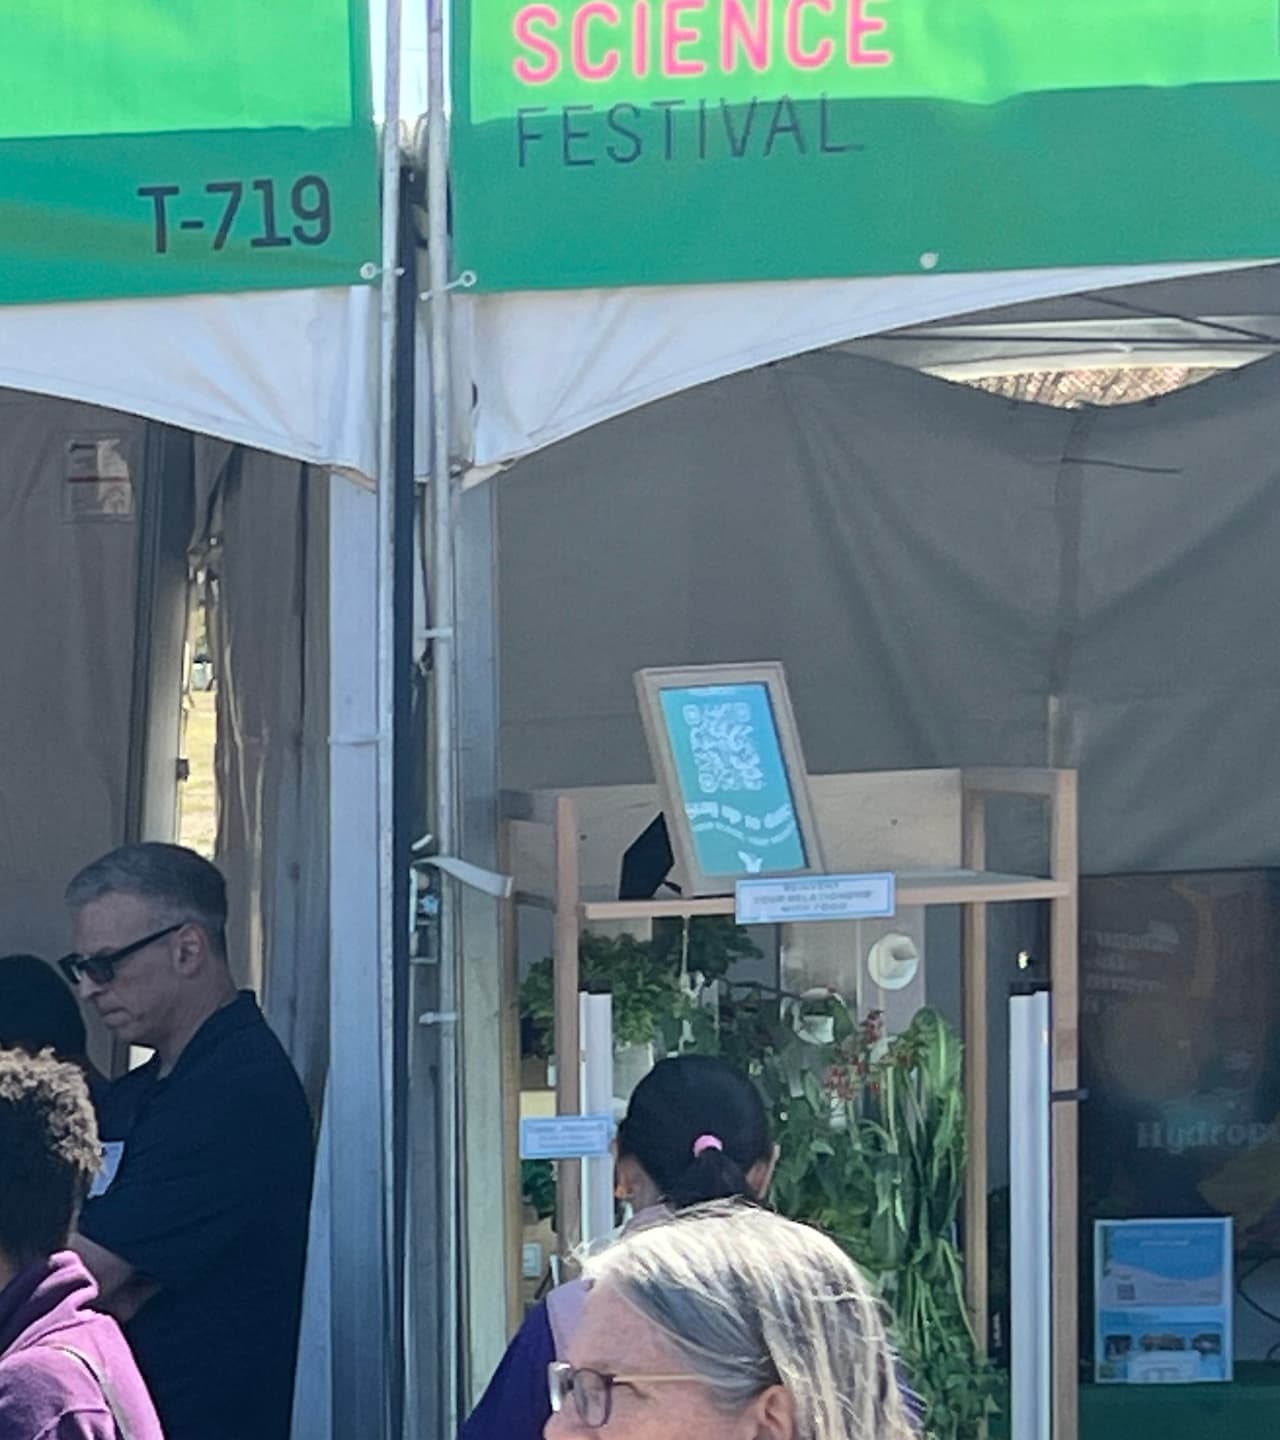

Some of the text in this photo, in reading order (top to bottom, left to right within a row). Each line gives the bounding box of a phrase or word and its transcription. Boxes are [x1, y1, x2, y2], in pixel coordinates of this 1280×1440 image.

[511, 0, 892, 84] SCIENCE
[515, 90, 853, 168] FESTIVAL
[137, 175, 333, 254] T-719
